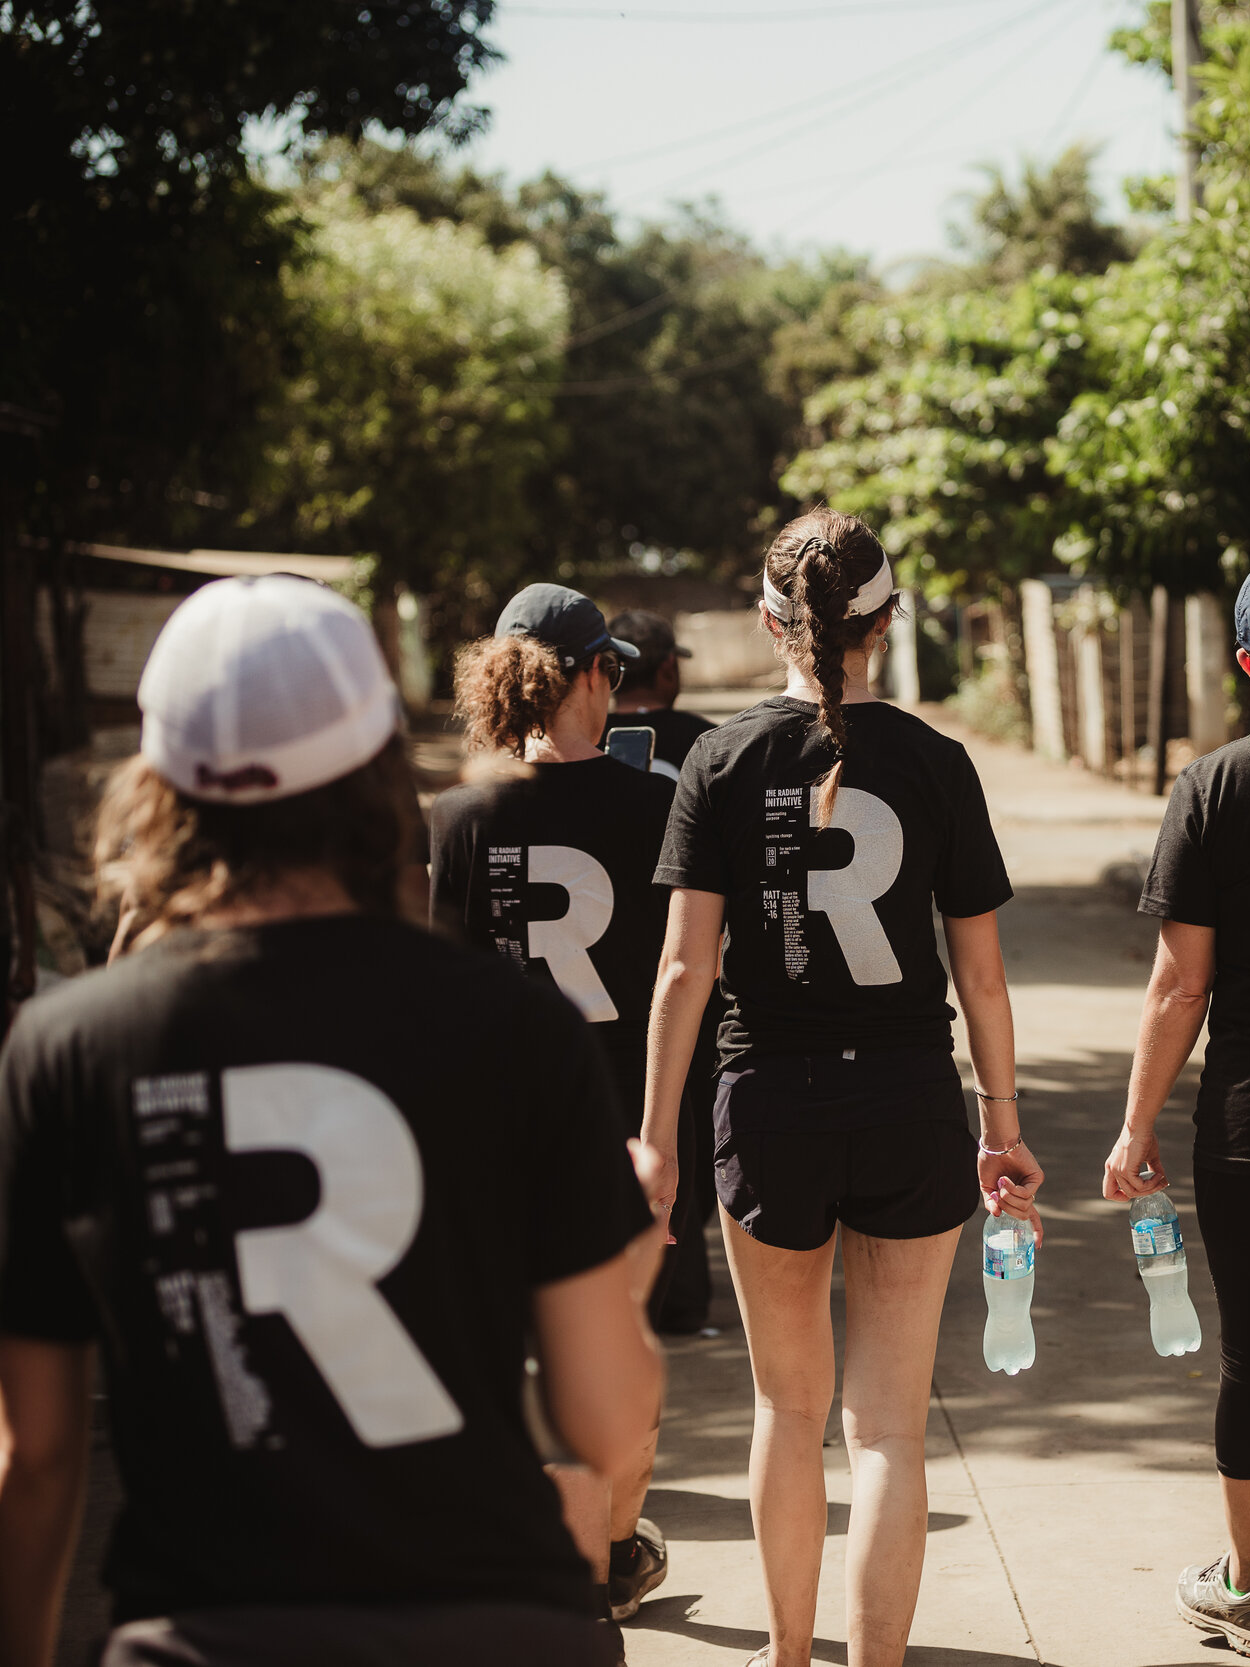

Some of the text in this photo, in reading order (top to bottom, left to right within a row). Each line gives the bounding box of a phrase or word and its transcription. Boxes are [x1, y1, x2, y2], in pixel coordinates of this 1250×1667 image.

[778, 788, 803, 796] RADIANT
[766, 796, 802, 807] INITIATIVE
[489, 855, 520, 863] INITIATIVE
[808, 786, 904, 985] R
[763, 890, 780, 899] MATT
[763, 900, 777, 909] 5:14
[768, 910, 778, 919] -16
[528, 845, 619, 1023] R
[221, 1062, 464, 1449] R
